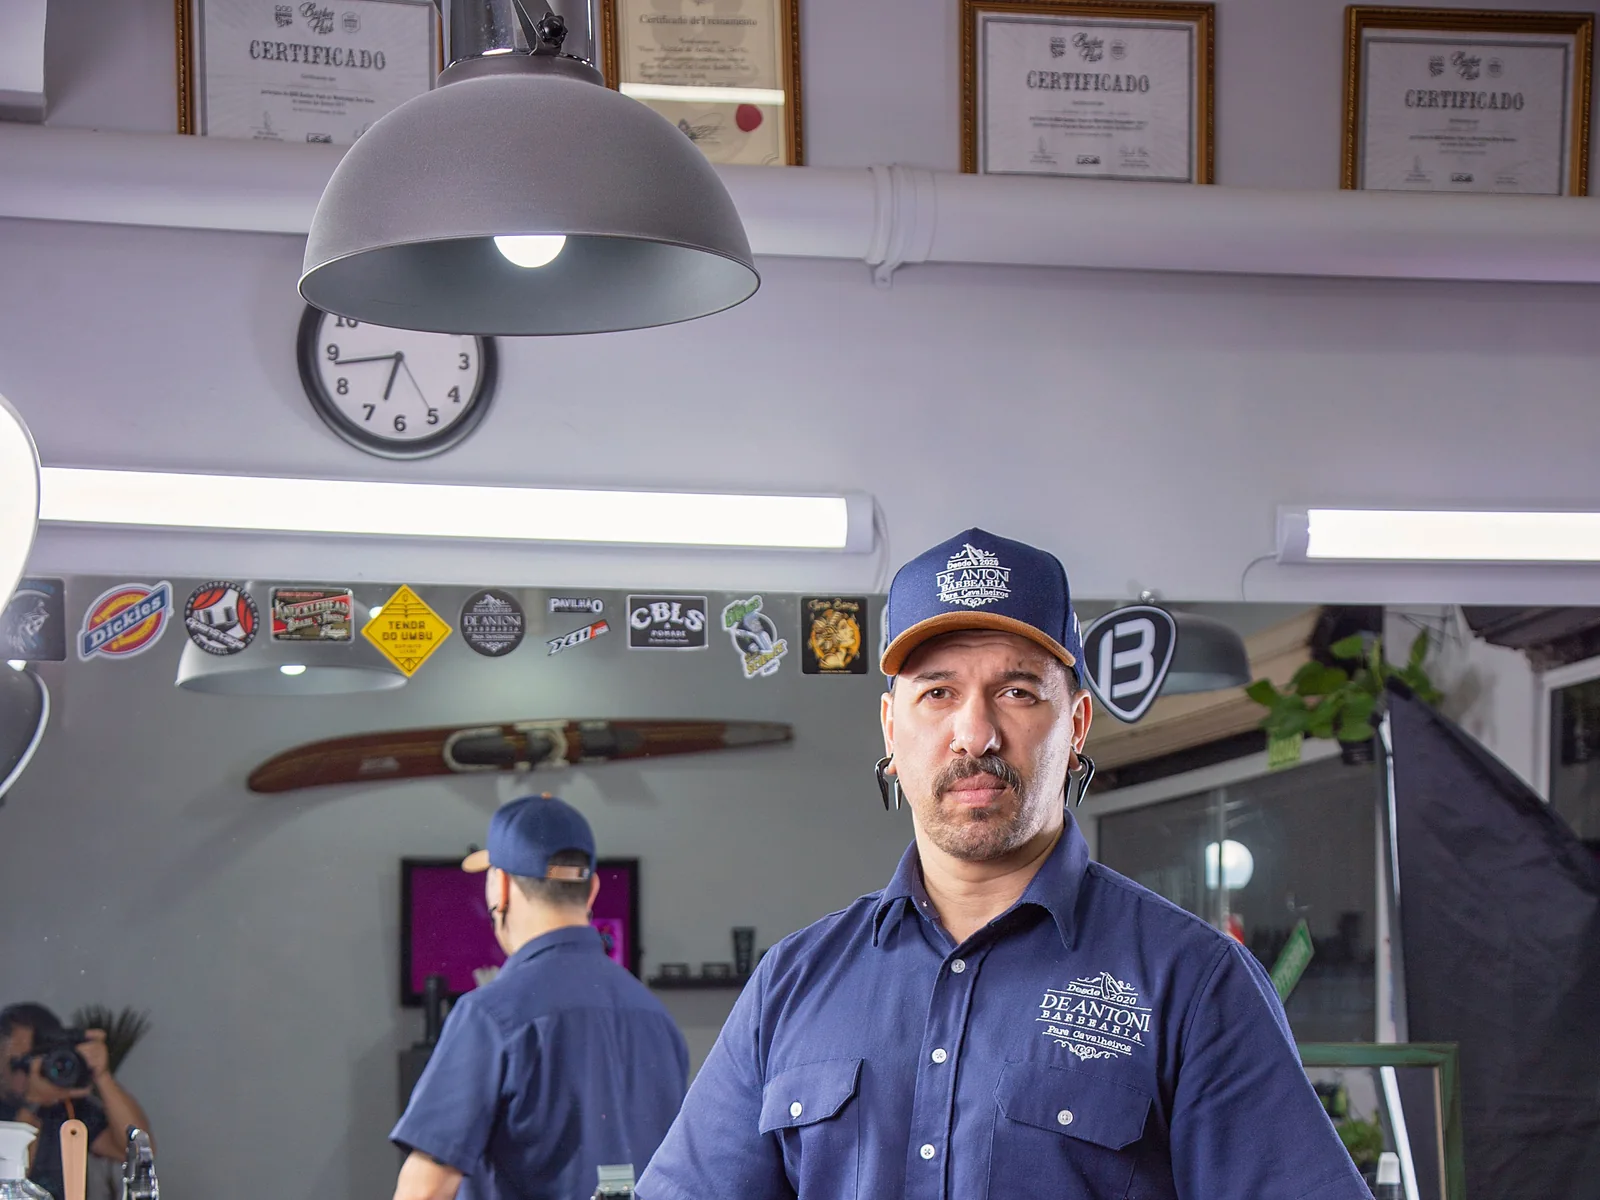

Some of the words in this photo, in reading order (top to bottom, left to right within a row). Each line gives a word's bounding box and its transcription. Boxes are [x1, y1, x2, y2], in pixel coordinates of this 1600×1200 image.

[639, 14, 688, 25] Certificado
[250, 40, 386, 70] CERTIFICADO
[1027, 70, 1150, 93] CERTIFICADO
[1405, 89, 1525, 111] CERTIFICADO
[326, 343, 340, 361] 9
[458, 353, 470, 370] 3
[336, 377, 349, 395] 8
[447, 386, 461, 403] 4
[363, 403, 376, 421] 7
[427, 408, 439, 425] 5
[394, 415, 406, 432] 6
[947, 560, 972, 569] Desde
[936, 572, 955, 587] DE
[960, 569, 1010, 583] ANTONI
[941, 579, 1007, 592] BARBEARIA
[940, 592, 958, 601] Para
[961, 588, 1009, 598] Cavalheiros
[91, 596, 162, 647] Dickies
[464, 615, 479, 626] DE
[480, 615, 522, 626] ANTONI
[631, 601, 705, 632] CBLS
[382, 631, 397, 641] DO
[401, 631, 433, 641] UMBU
[1098, 618, 1156, 701] B
[1066, 984, 1100, 996] Desde
[1109, 994, 1137, 1005] 2020
[1039, 993, 1072, 1011] DE
[1070, 999, 1151, 1032] ANTONI
[1041, 1010, 1142, 1041] BARBEARIA
[1047, 1025, 1069, 1036] Para
[1072, 1030, 1132, 1052] Cavalheiros
